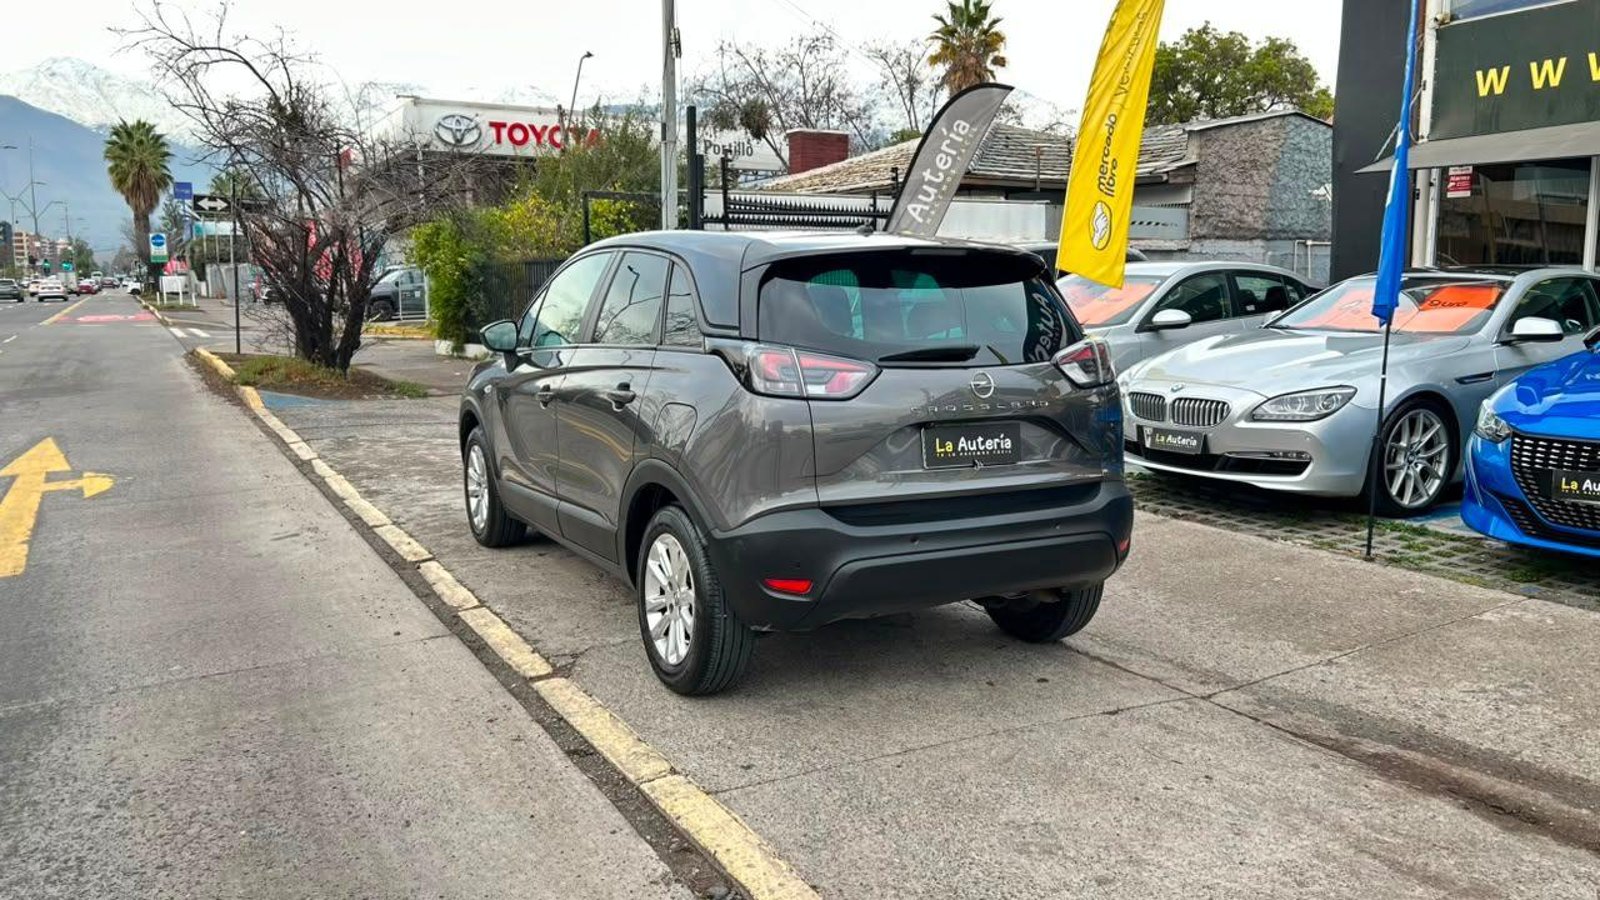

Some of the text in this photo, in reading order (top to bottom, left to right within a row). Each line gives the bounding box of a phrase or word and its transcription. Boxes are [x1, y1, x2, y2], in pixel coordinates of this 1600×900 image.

[1098, 113, 1117, 194] mercado
[906, 119, 970, 223] Autería
[1105, 158, 1118, 197] libre
[935, 433, 1012, 453] La Autería
[1155, 433, 1165, 443] La
[1561, 477, 1579, 490] La
